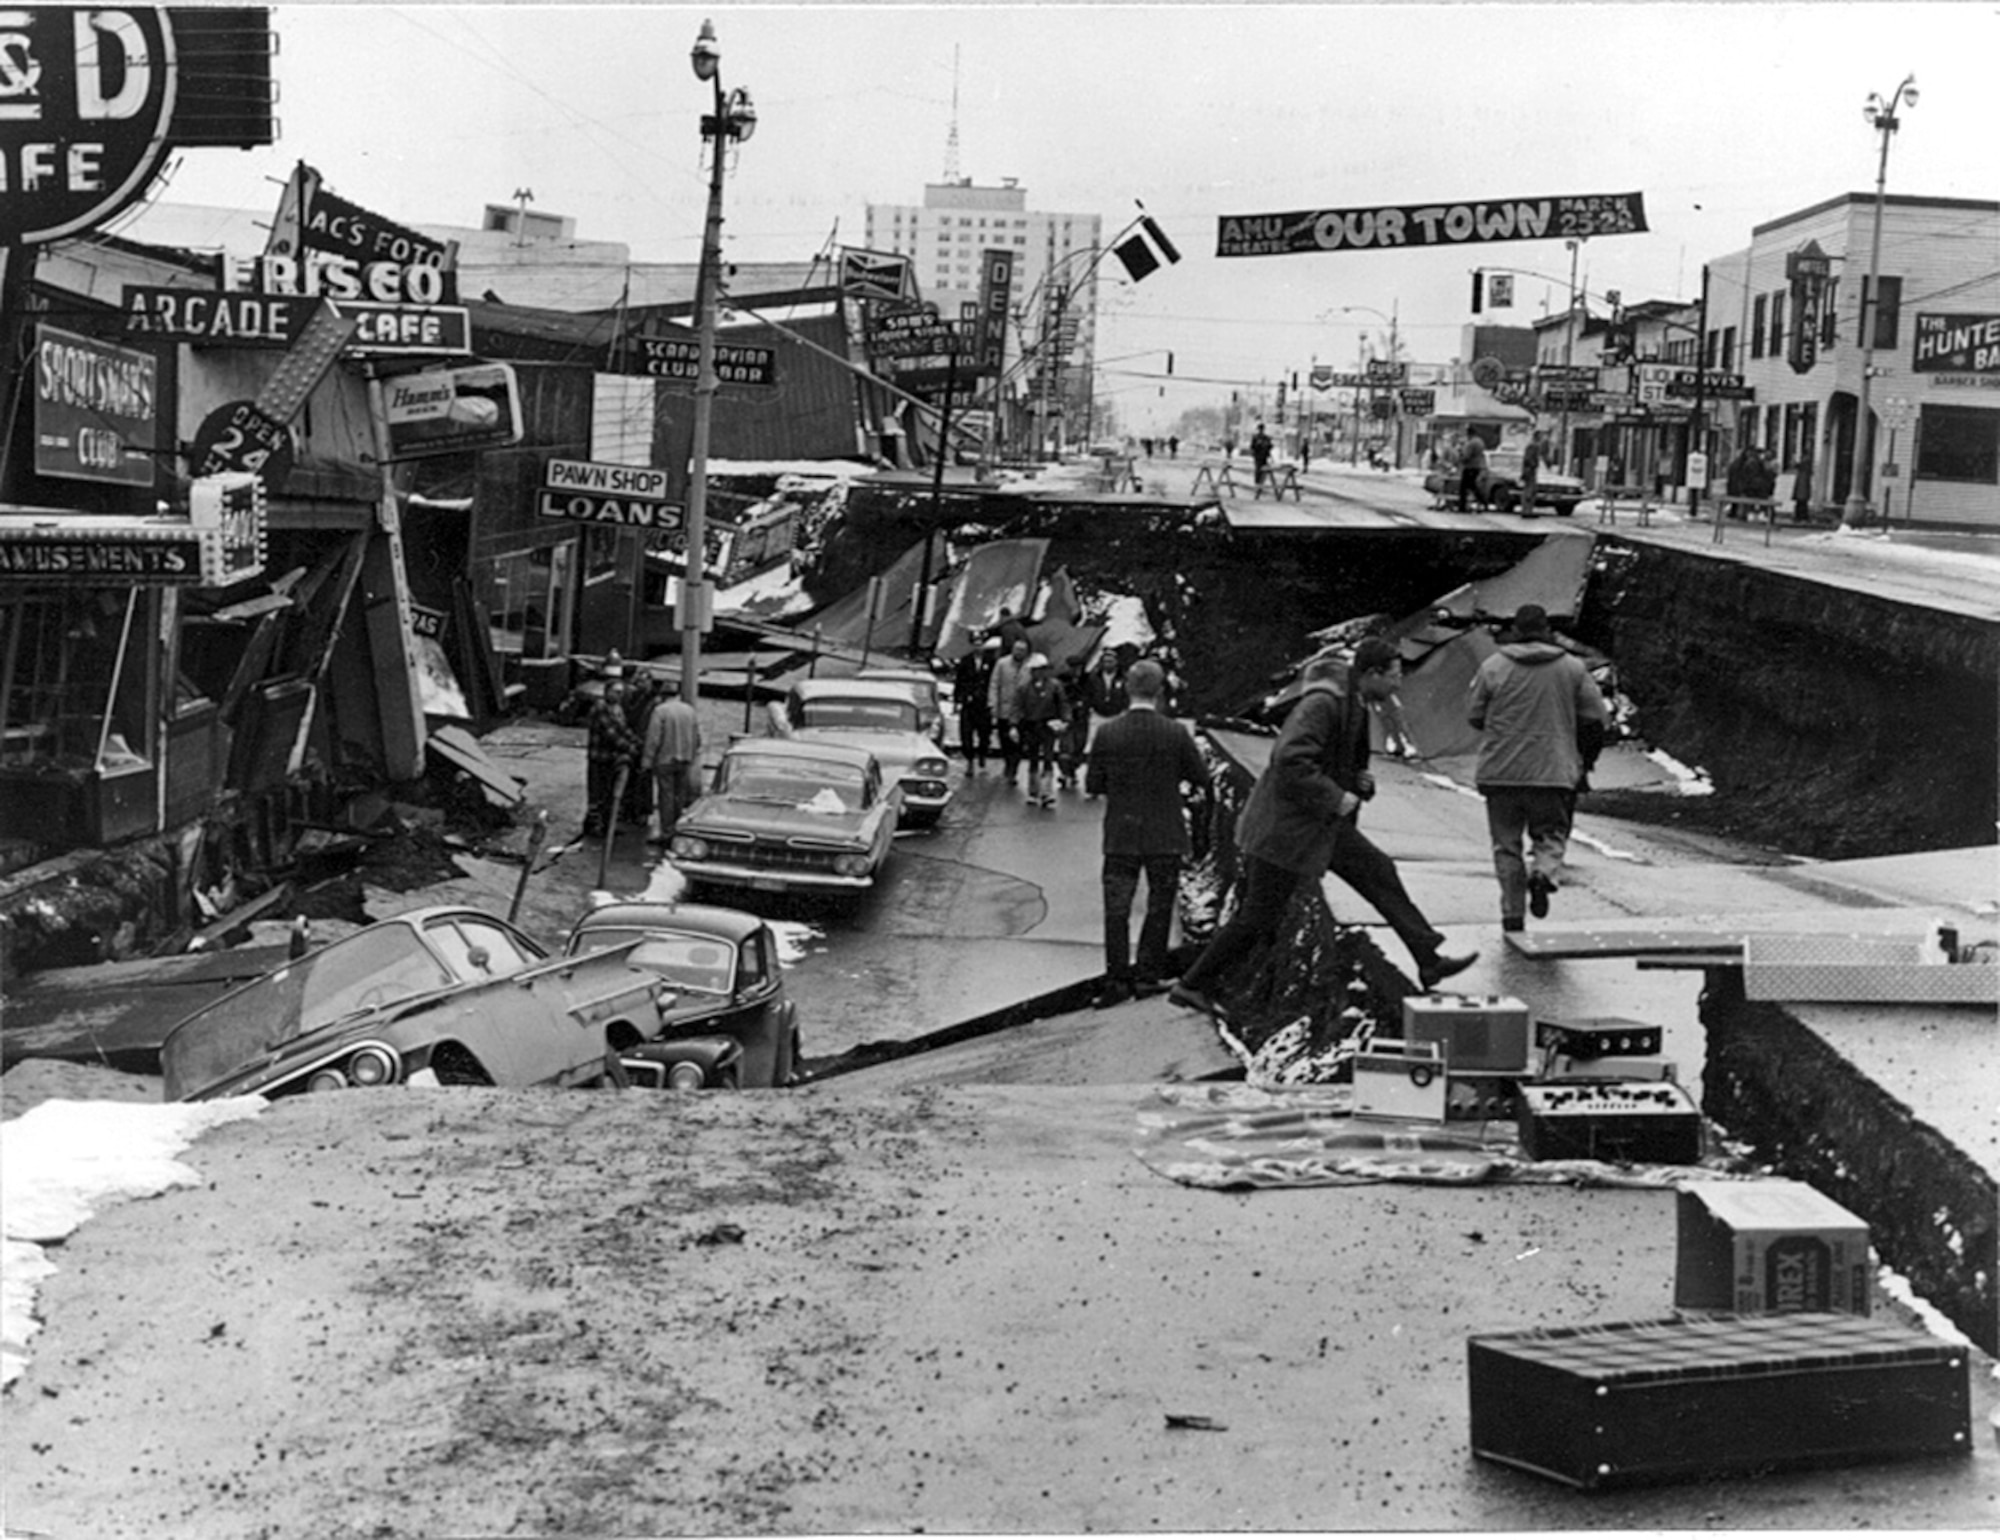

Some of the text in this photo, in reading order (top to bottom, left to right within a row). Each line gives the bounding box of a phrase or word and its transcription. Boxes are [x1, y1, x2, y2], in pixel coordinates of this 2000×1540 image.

[74, 11, 150, 119] D
[0, 143, 105, 191] FE
[1222, 218, 1282, 241] AMU
[1314, 207, 1406, 249] OUR
[1412, 200, 1551, 243] TOWN
[374, 231, 445, 270] FOTO
[126, 292, 290, 341] ARCADE
[356, 311, 442, 345] CAFE
[1919, 317, 1947, 331] THE
[646, 358, 763, 382] CLUB BAR
[79, 427, 118, 469] CLUB
[231, 406, 287, 451] OPEN
[211, 427, 270, 475] 24
[552, 463, 663, 493] PAWN SHOP
[540, 493, 682, 529] LOANS
